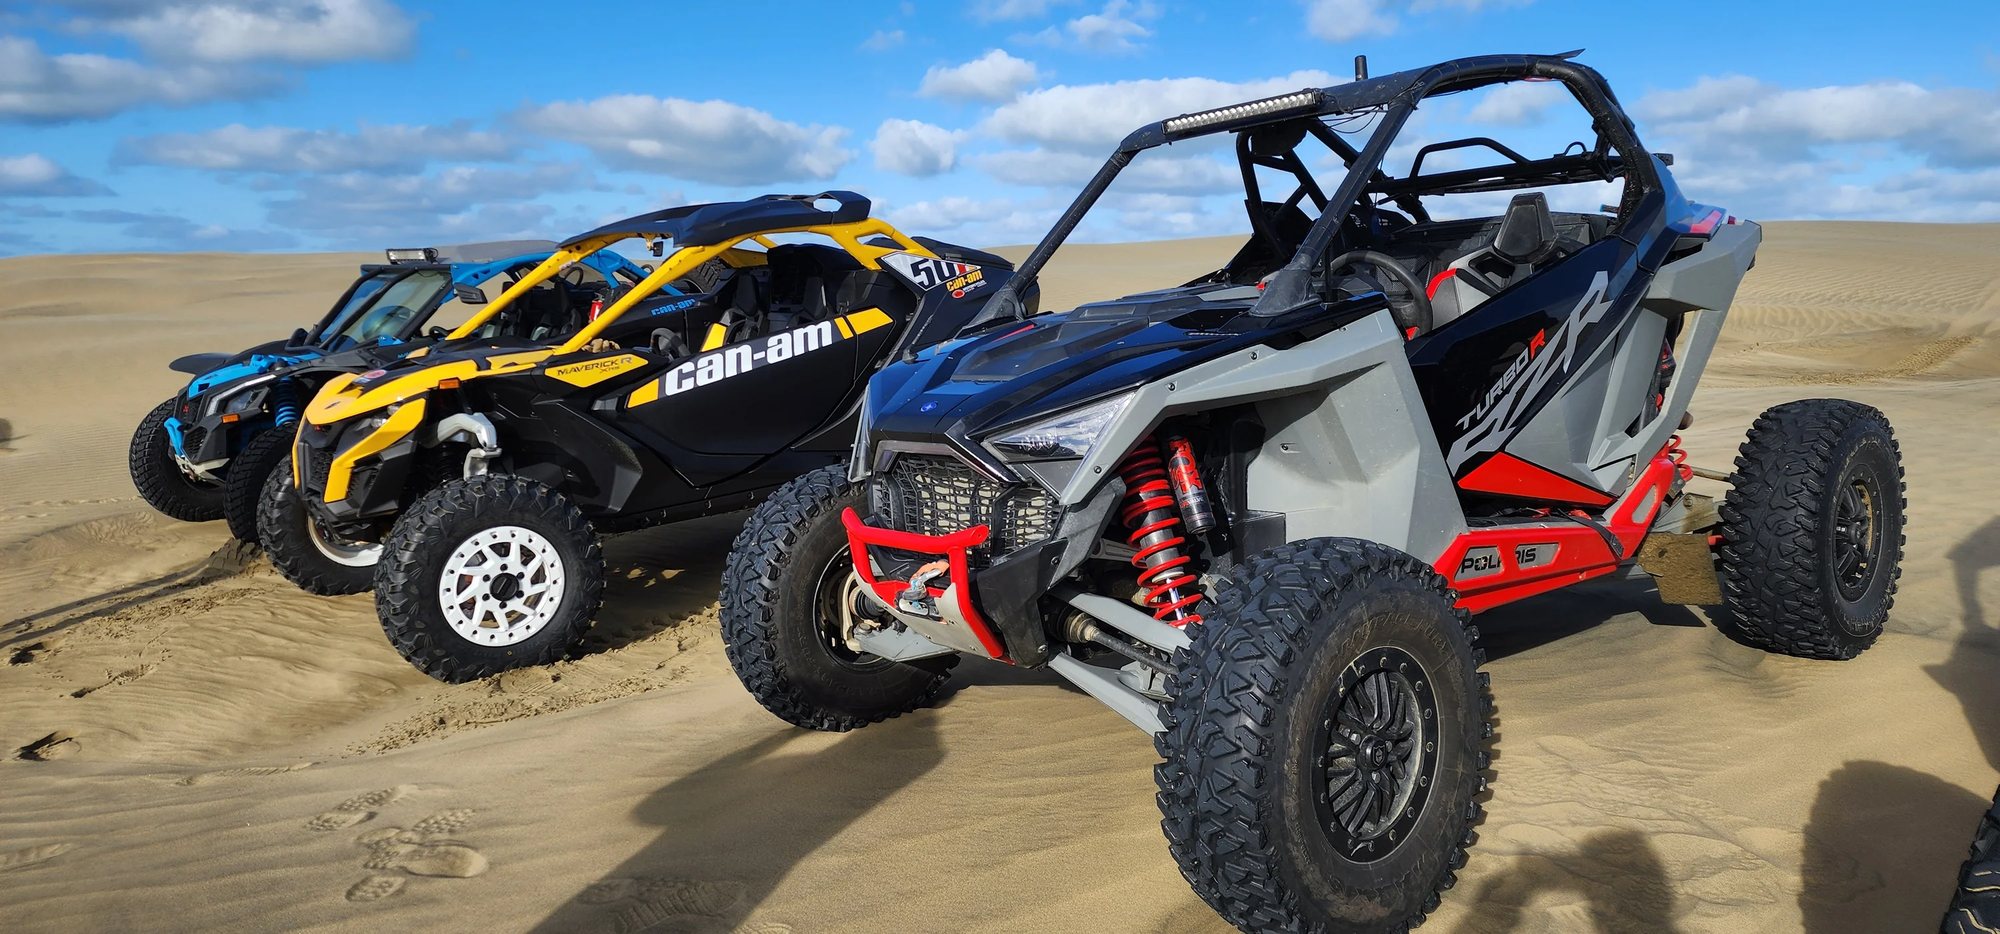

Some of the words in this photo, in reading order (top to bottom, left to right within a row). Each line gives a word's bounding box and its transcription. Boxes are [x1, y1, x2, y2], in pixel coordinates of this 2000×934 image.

[946, 270, 983, 292] can-am
[651, 298, 696, 316] can-am
[557, 359, 619, 376] MAVERICK
[665, 320, 833, 396] can-am
[1446, 270, 1615, 478] RZR
[1455, 347, 1529, 430] TURBO
[1530, 328, 1546, 360] R
